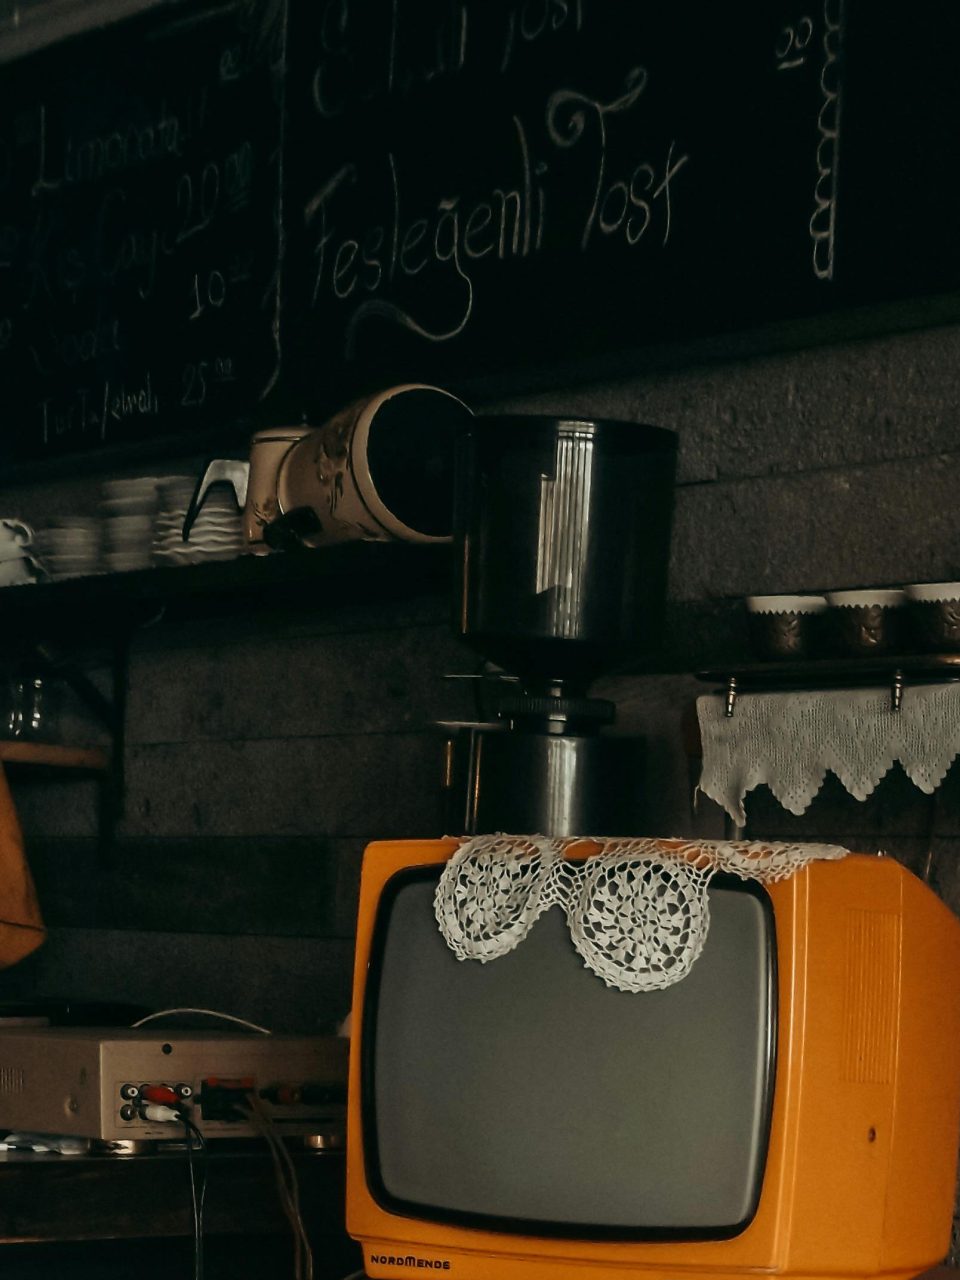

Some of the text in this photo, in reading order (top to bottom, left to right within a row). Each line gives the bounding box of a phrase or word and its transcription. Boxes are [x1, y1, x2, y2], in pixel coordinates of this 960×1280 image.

[544, 64, 692, 253] Tost
[188, 268, 227, 321] 10
[370, 1255, 451, 1270] NORDMENDE
